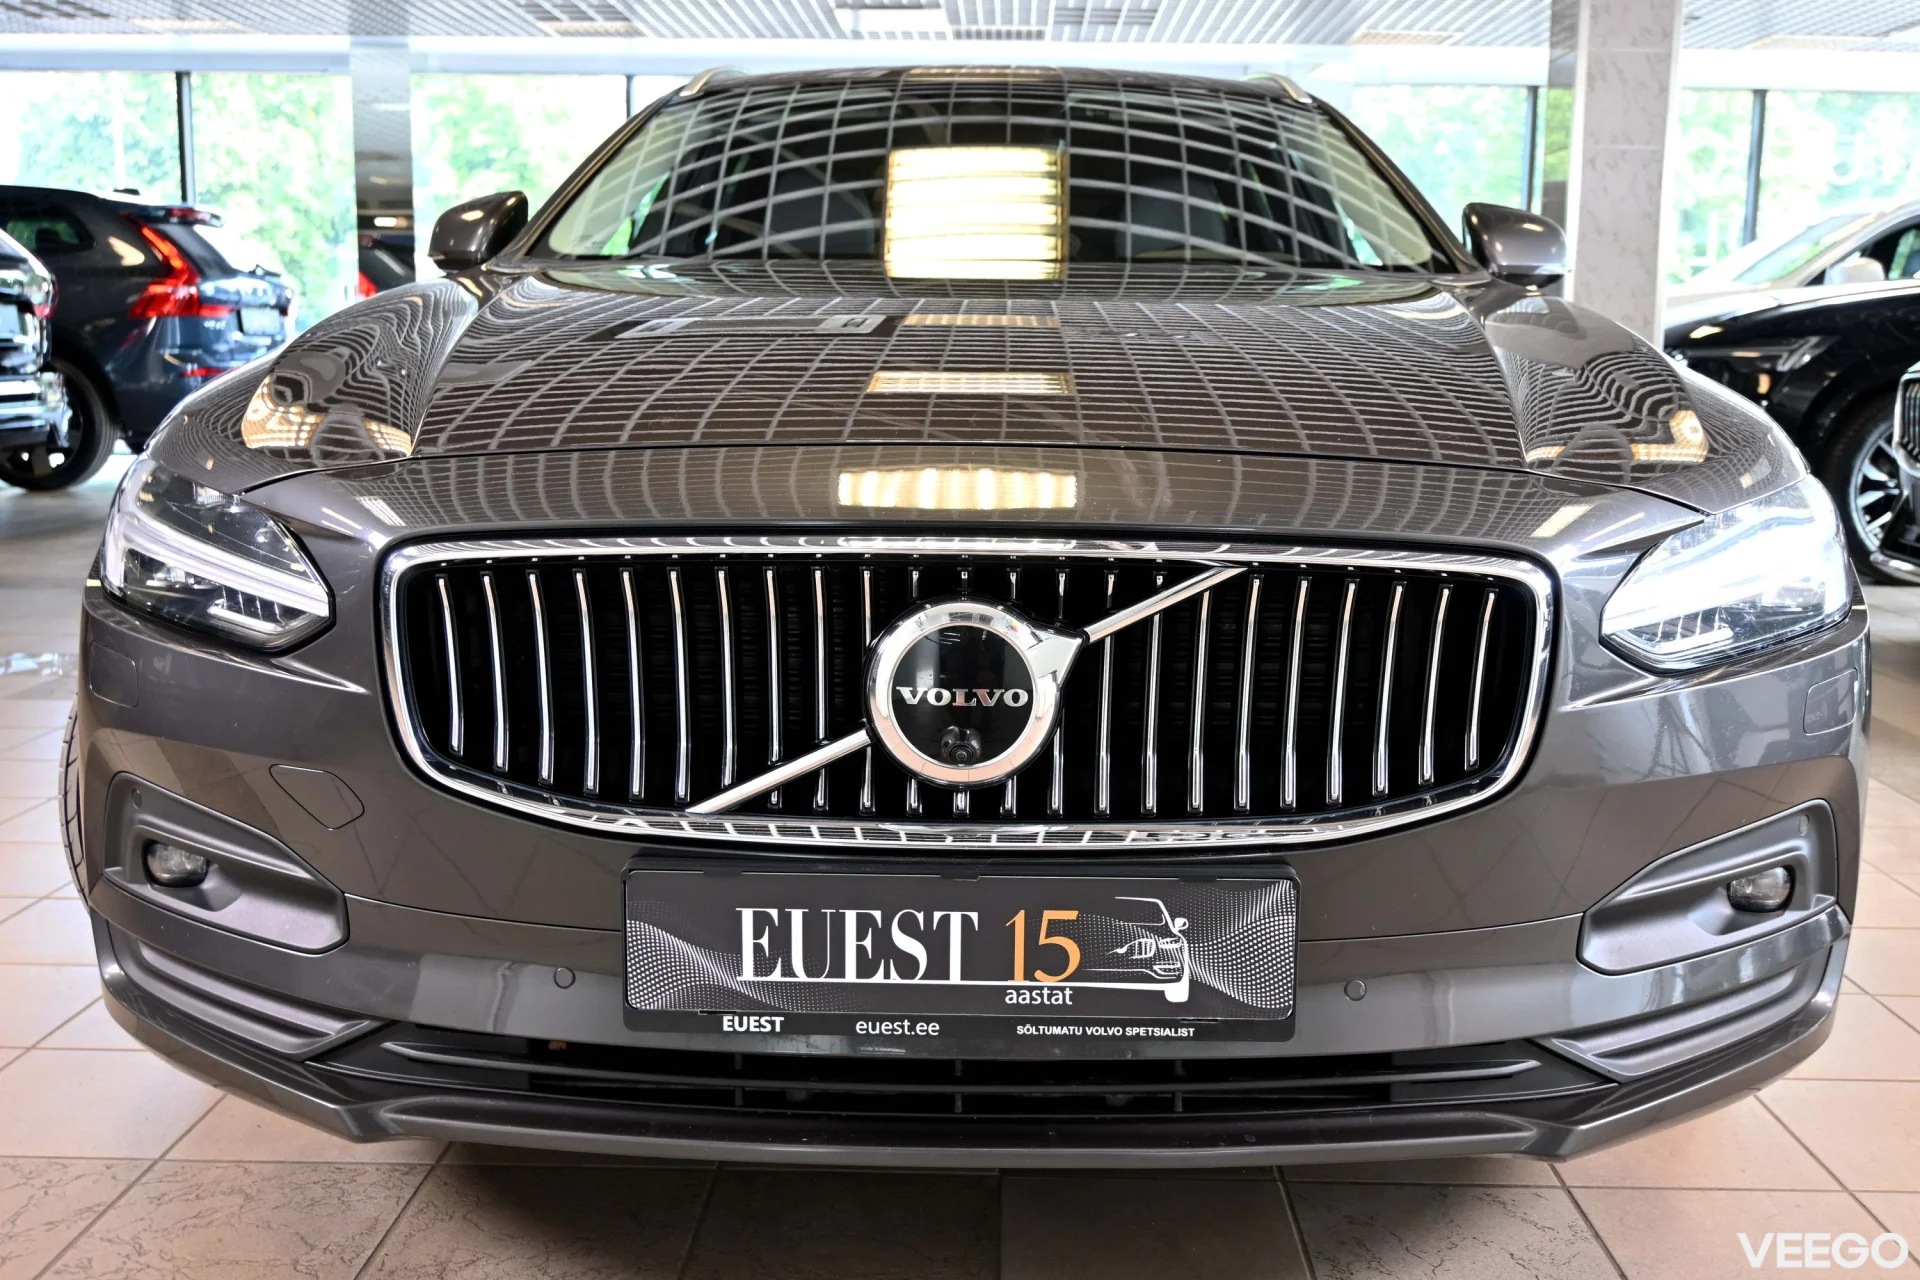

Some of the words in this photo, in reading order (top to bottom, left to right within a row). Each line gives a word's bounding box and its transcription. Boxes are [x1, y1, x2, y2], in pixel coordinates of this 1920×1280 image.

[896, 686, 1029, 707] VOLVO
[736, 908, 979, 982] EUEST
[1005, 909, 1081, 983] 15
[1005, 986, 1073, 1005] aastat
[722, 1015, 784, 1032] EUEST
[855, 1019, 940, 1036] euest.ee
[1016, 1023, 1082, 1035] SÕLTUMATU
[1085, 1026, 1123, 1036] VOLVO
[1125, 1027, 1195, 1037] SPETSIALIST
